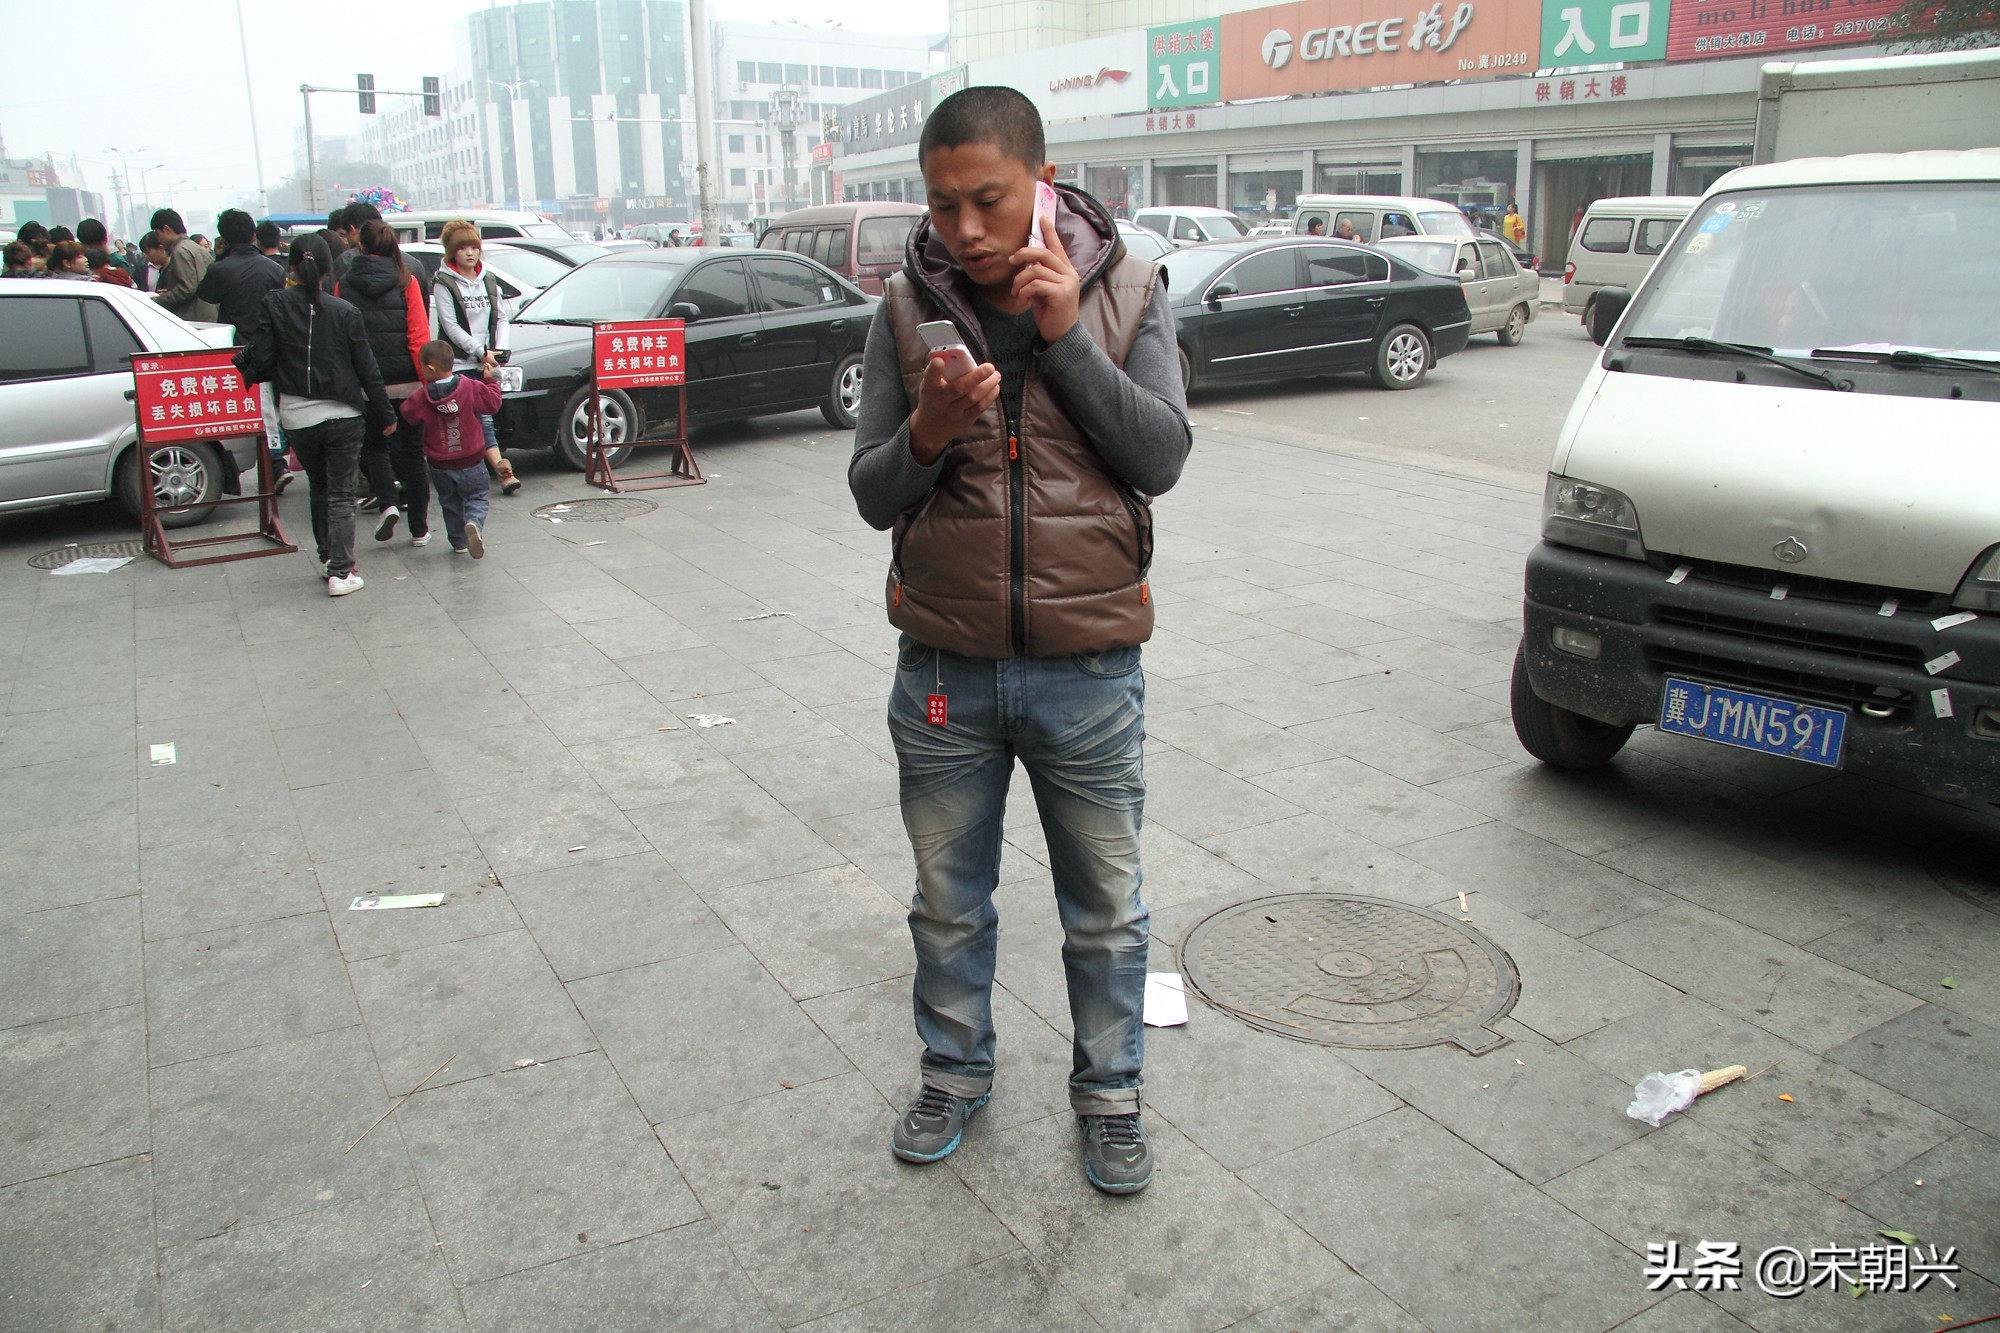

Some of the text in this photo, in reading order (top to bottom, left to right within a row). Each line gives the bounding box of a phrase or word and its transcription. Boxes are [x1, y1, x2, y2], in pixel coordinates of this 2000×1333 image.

[1553, 1, 1651, 58] 入口
[1696, 10, 1736, 25] mo
[1153, 28, 1214, 56] 供销大楼
[1299, 17, 1404, 62] GREE
[1695, 32, 1766, 51] 供销大楼店
[1155, 61, 1210, 99] 入口
[1534, 75, 1627, 104] 供销大楼
[1145, 113, 1196, 132] 供销大楼
[1736, 211, 1761, 219] 2012
[611, 335, 668, 353] 免费停车
[603, 354, 679, 371] 丢失损坏自负
[160, 373, 239, 399] 免费停车
[151, 397, 257, 421] 丢失损坏自负
